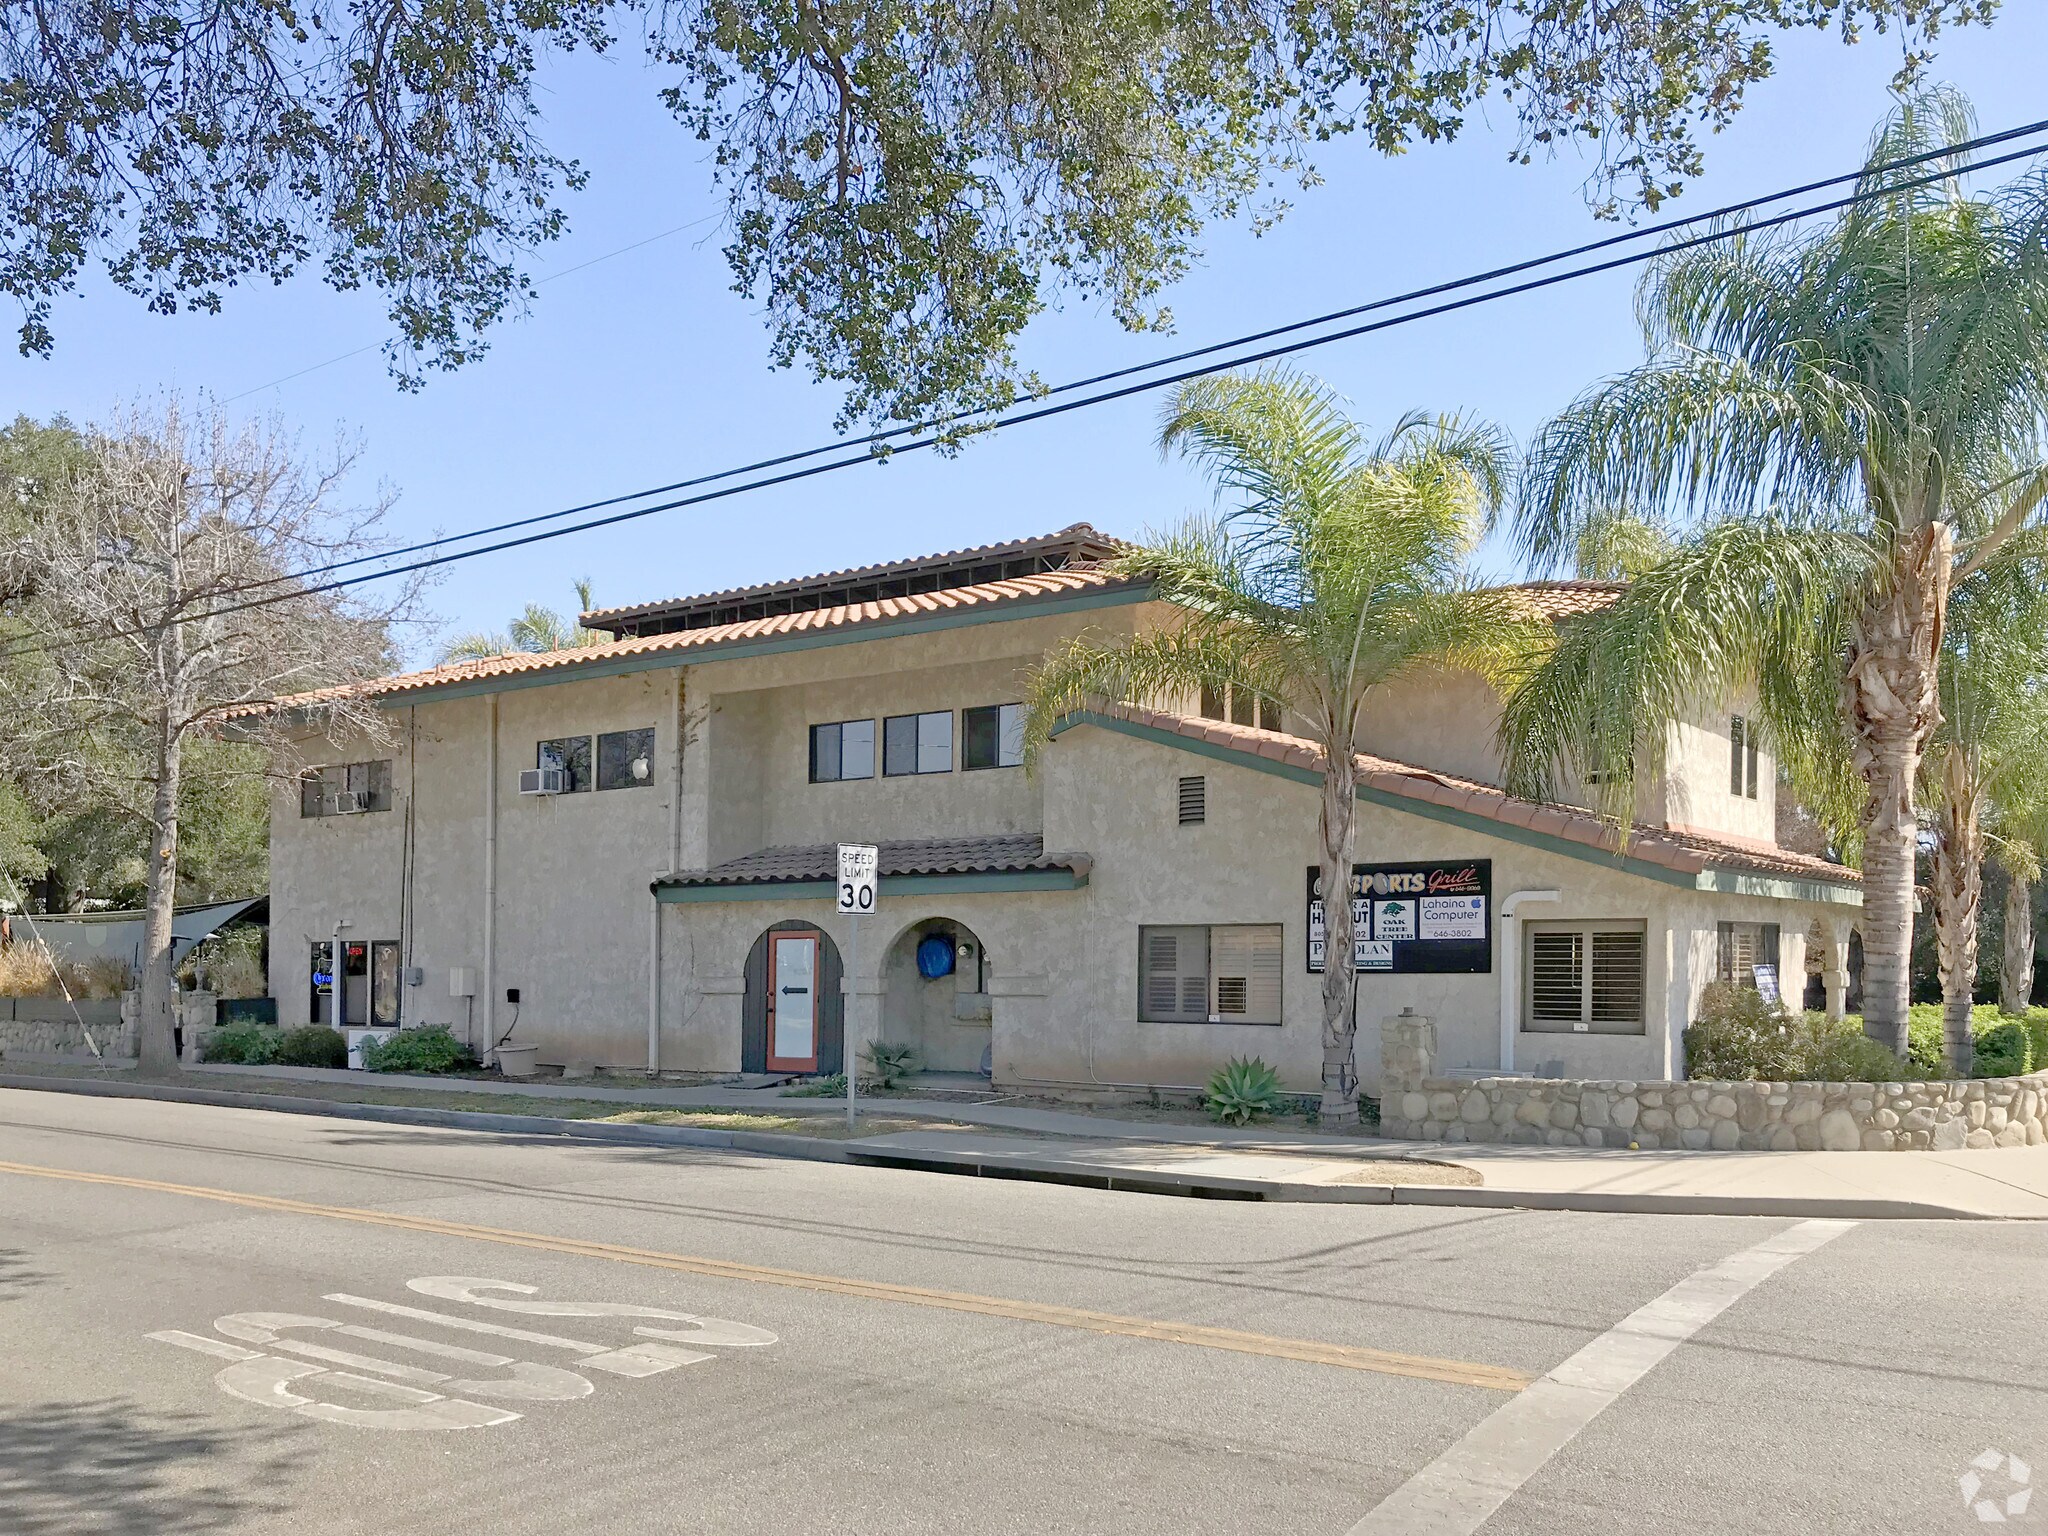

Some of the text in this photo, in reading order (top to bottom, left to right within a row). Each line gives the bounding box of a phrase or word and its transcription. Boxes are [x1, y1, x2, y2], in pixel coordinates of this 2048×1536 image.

[842, 852, 874, 865] SPEED
[844, 867, 870, 878] LIMIT
[1428, 869, 1479, 892] Grill
[841, 883, 873, 909] 30
[1422, 898, 1466, 909] Lahaina
[1424, 910, 1479, 922] Computer
[143, 1275, 779, 1431] STOP
